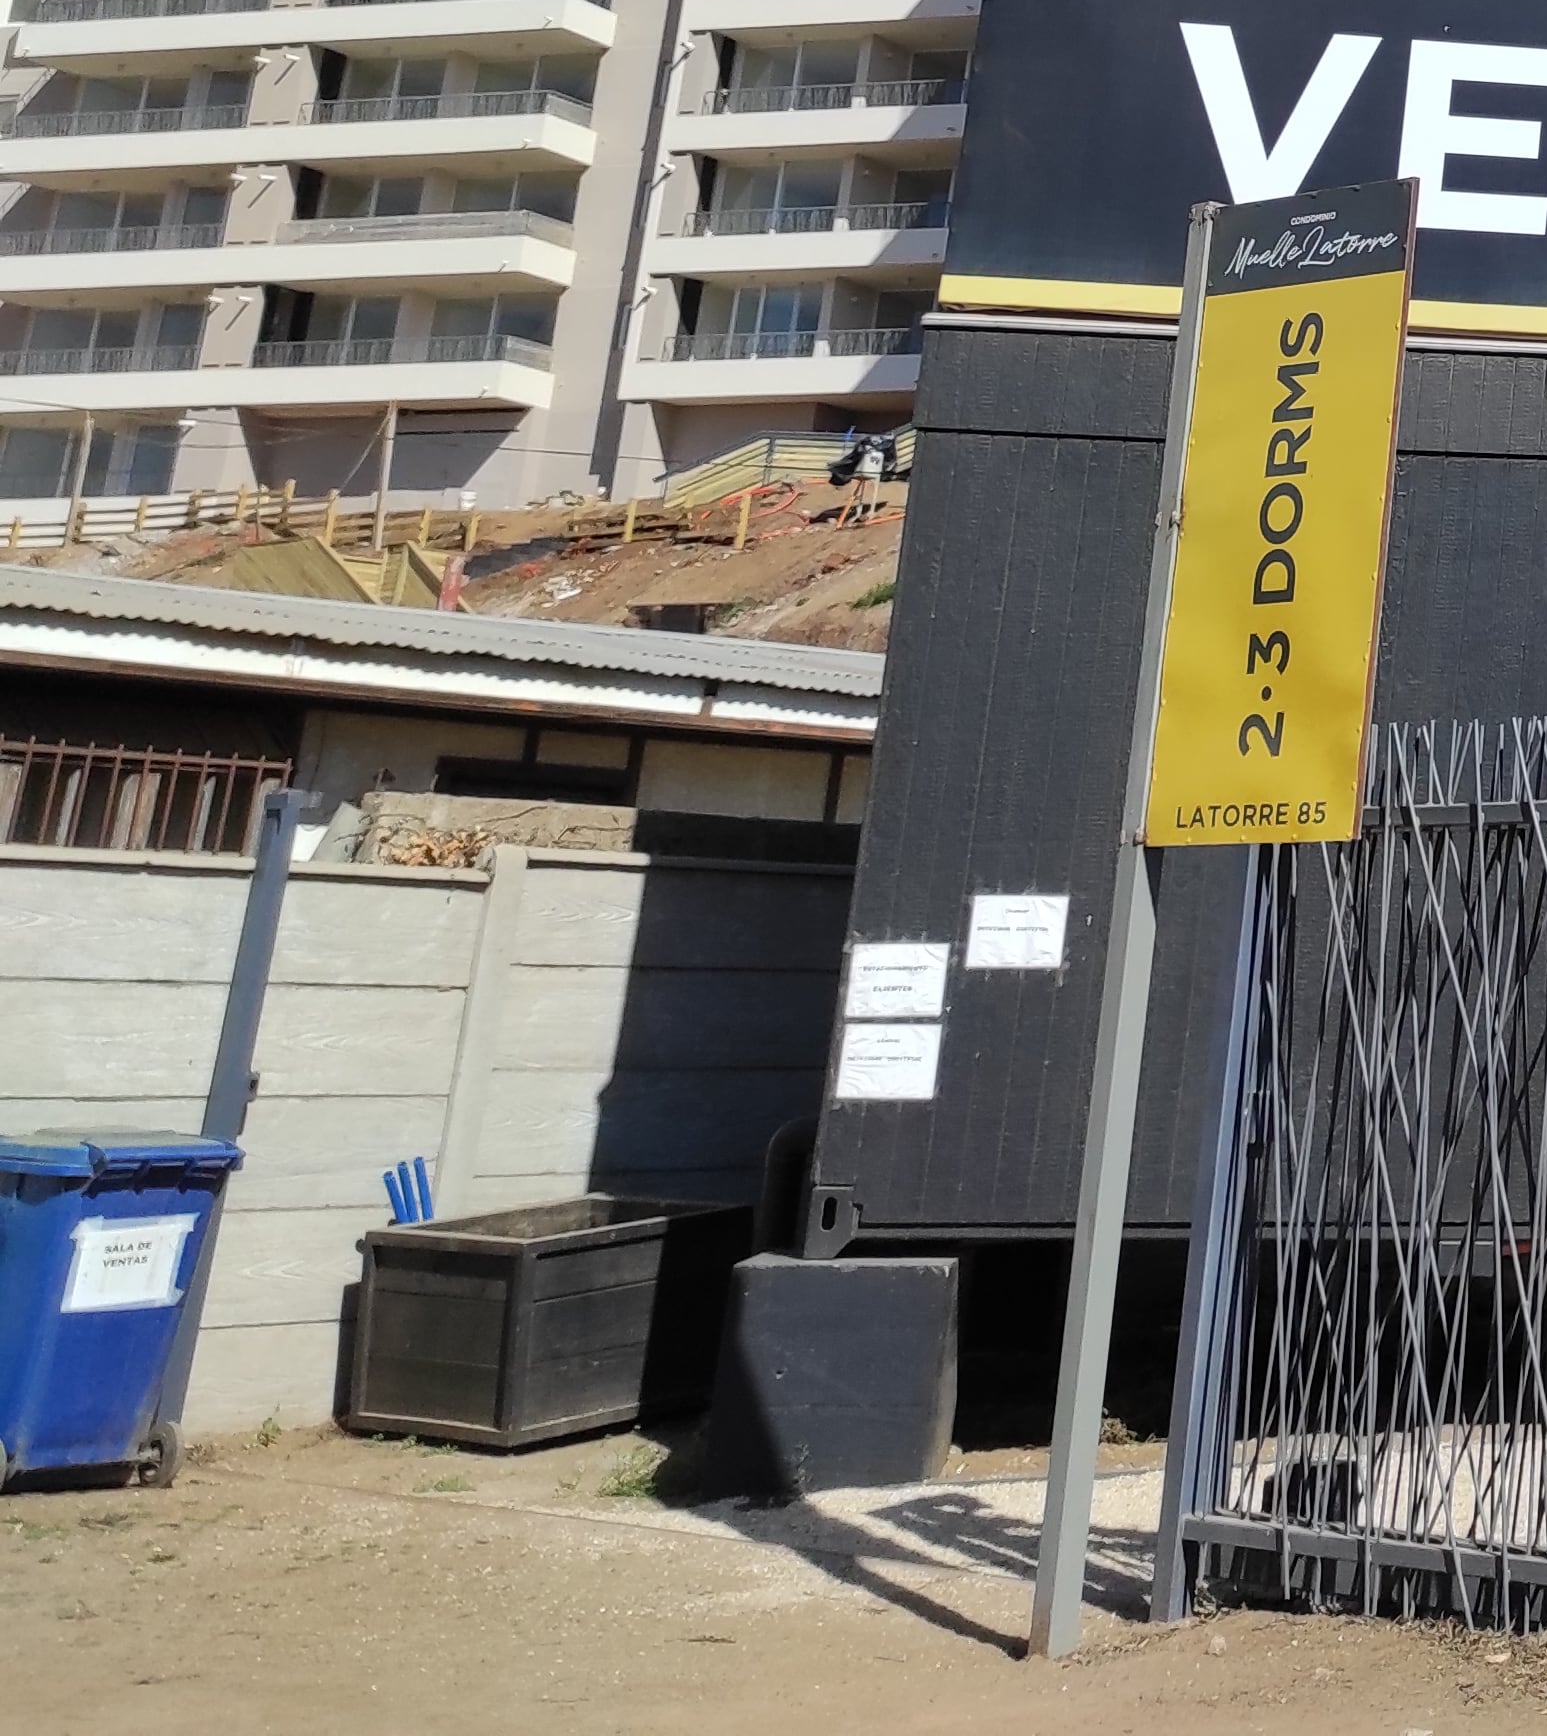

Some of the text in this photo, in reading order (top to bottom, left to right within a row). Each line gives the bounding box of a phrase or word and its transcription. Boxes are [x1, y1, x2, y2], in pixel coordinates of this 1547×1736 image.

[1224, 225, 1398, 280] Muelle Latorre
[1253, 311, 1324, 605] DORMS
[1176, 803, 1326, 829] LATORRE 85
[104, 1241, 152, 1254] SALA DE
[103, 1256, 149, 1268] VENTAS
